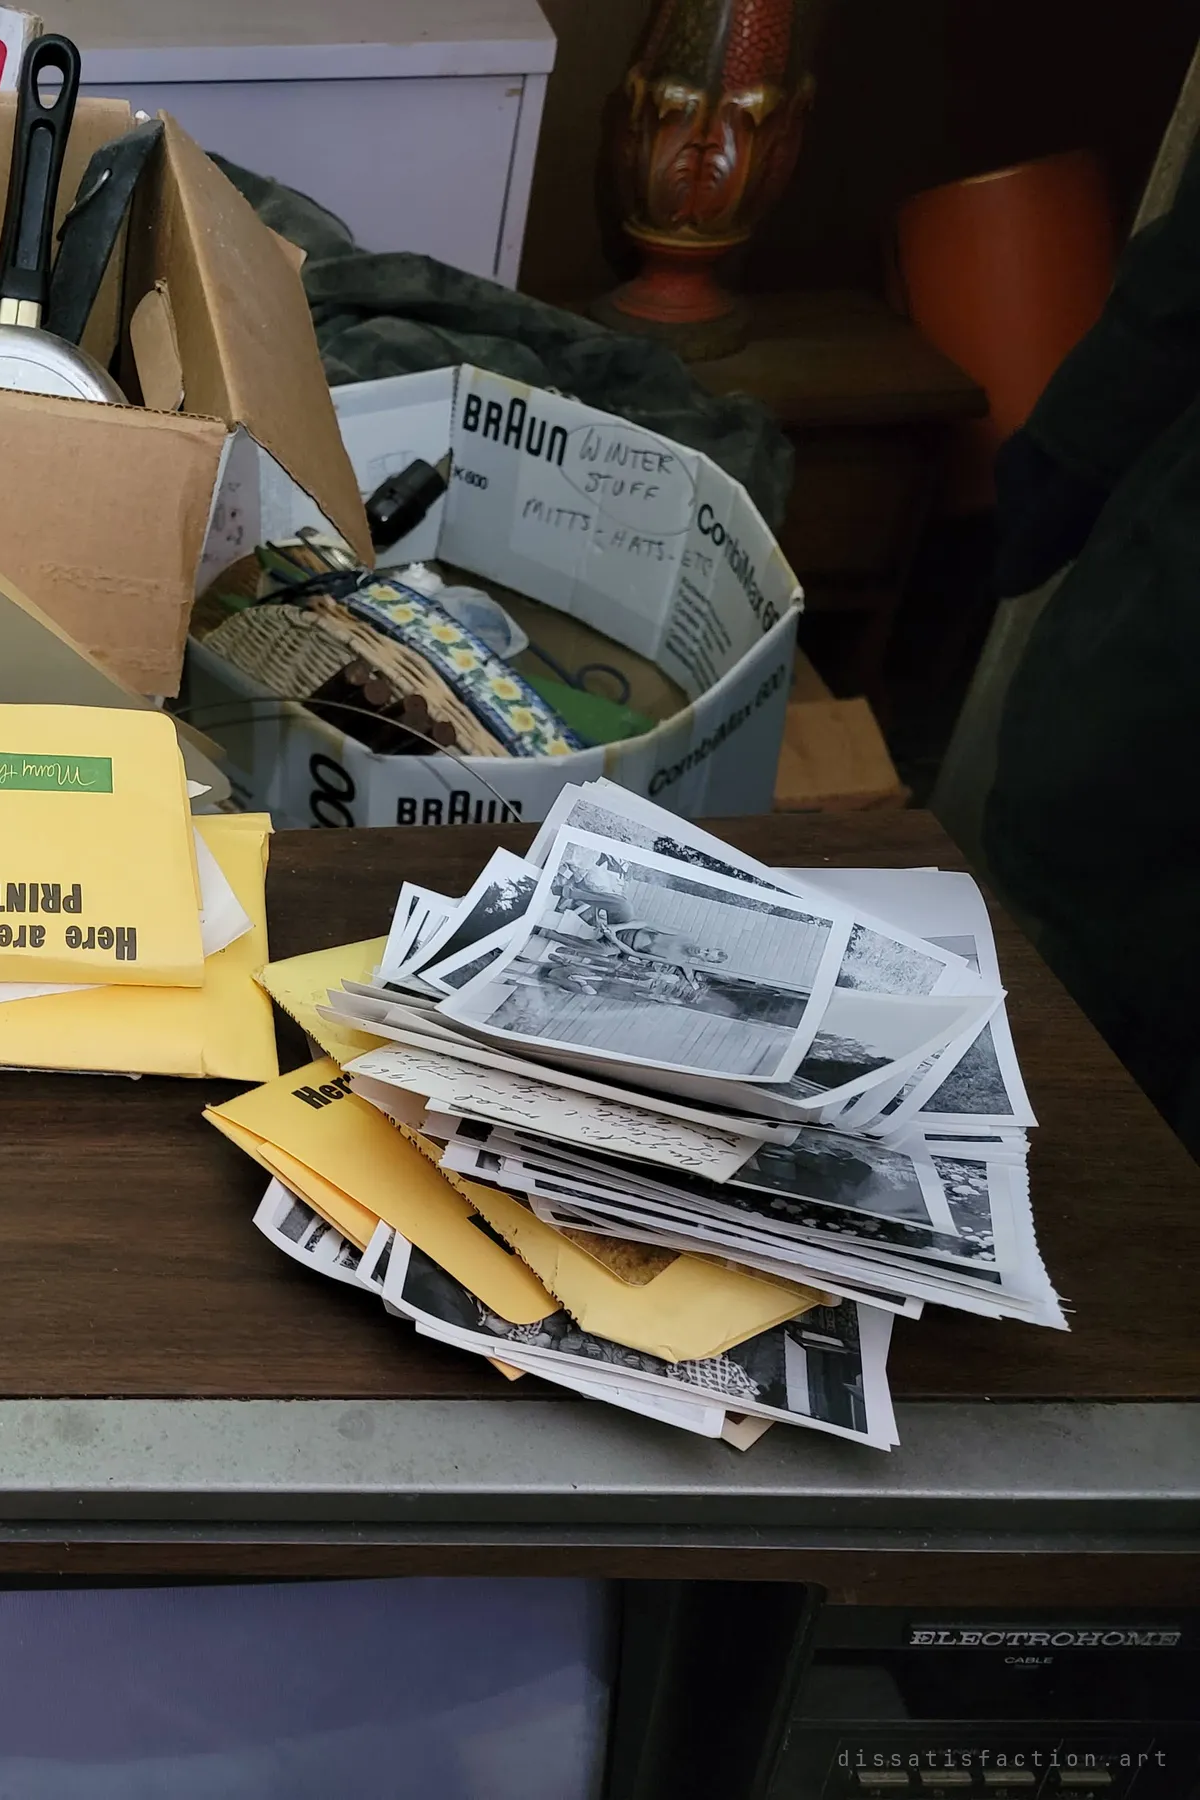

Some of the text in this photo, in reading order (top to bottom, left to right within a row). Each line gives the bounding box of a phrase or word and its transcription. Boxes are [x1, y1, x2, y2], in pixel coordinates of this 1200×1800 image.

[463, 393, 568, 467] BRAUN
[578, 427, 675, 475] WINTER
[584, 471, 661, 500] STUFF
[522, 498, 592, 533] MITTS
[681, 550, 714, 577] ETC
[21, 758, 97, 787] Many
[396, 790, 522, 826] BRAUN
[64, 925, 138, 962] Here
[909, 1630, 1182, 1647] ELECTROHOME
[1004, 1656, 1054, 1665] CABLE
